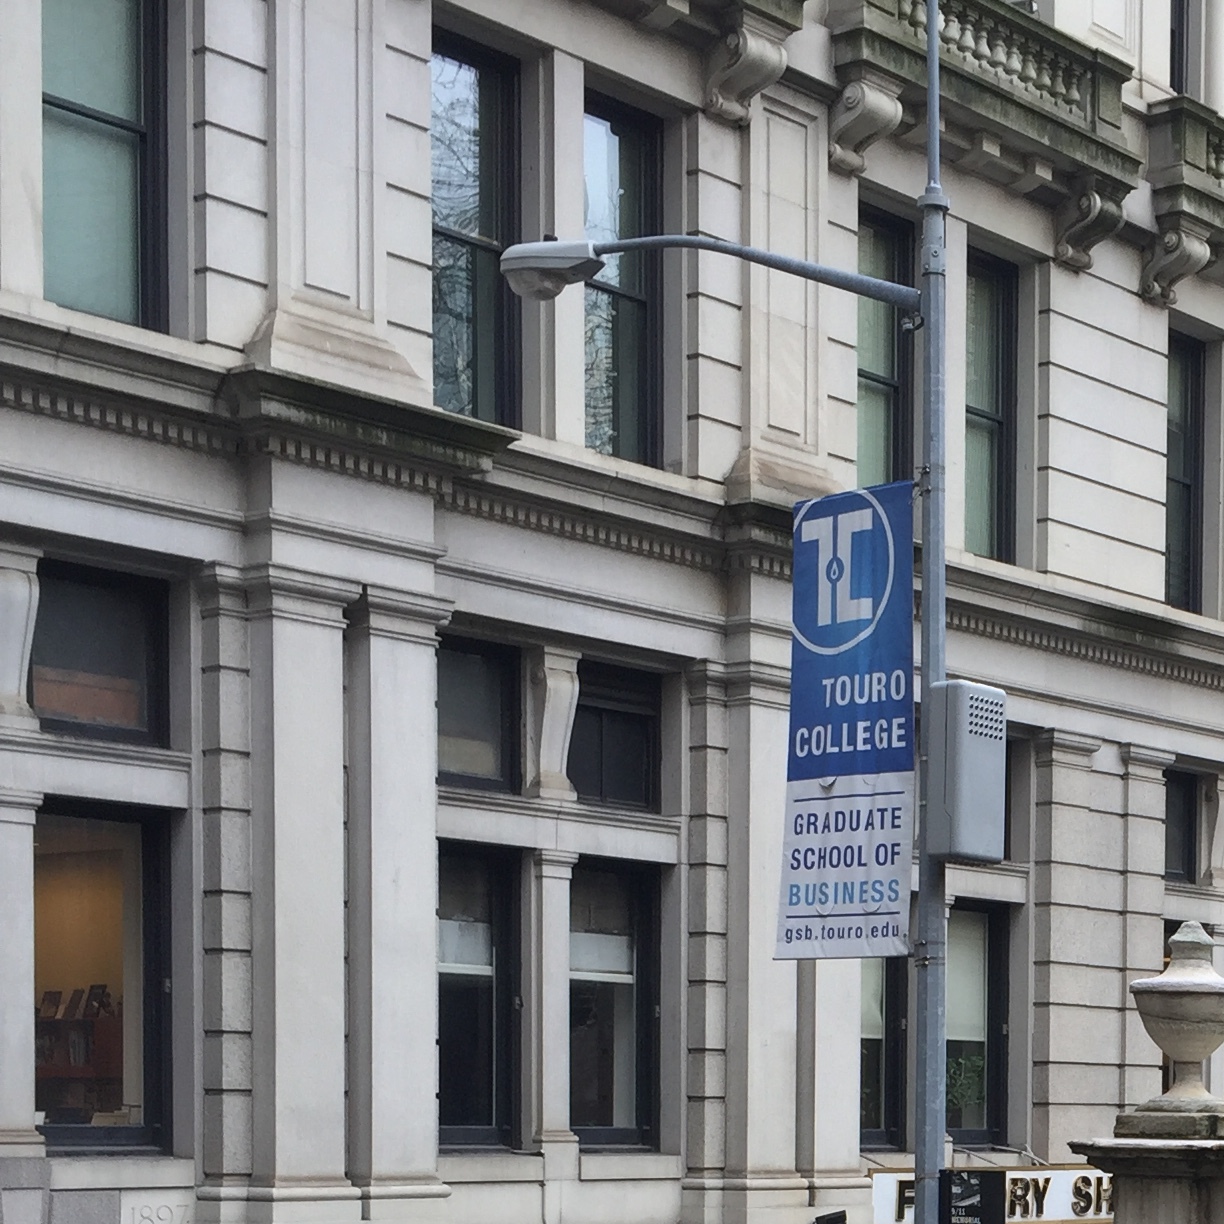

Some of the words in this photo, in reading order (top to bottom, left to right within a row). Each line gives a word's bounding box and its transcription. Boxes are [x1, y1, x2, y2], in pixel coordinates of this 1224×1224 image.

[822, 670, 906, 708] TOURO
[796, 717, 906, 758] COLLEGE
[794, 807, 902, 835] GRADUATE
[790, 845, 868, 870] SCHOOL
[875, 843, 901, 866] OF
[788, 879, 900, 906] BUSINESS
[785, 921, 900, 944] gsb.touro.edu
[1071, 1175, 1114, 1217] SH
[951, 1207, 966, 1216] 9/11
[951, 1216, 982, 1224] MEMORIAL
